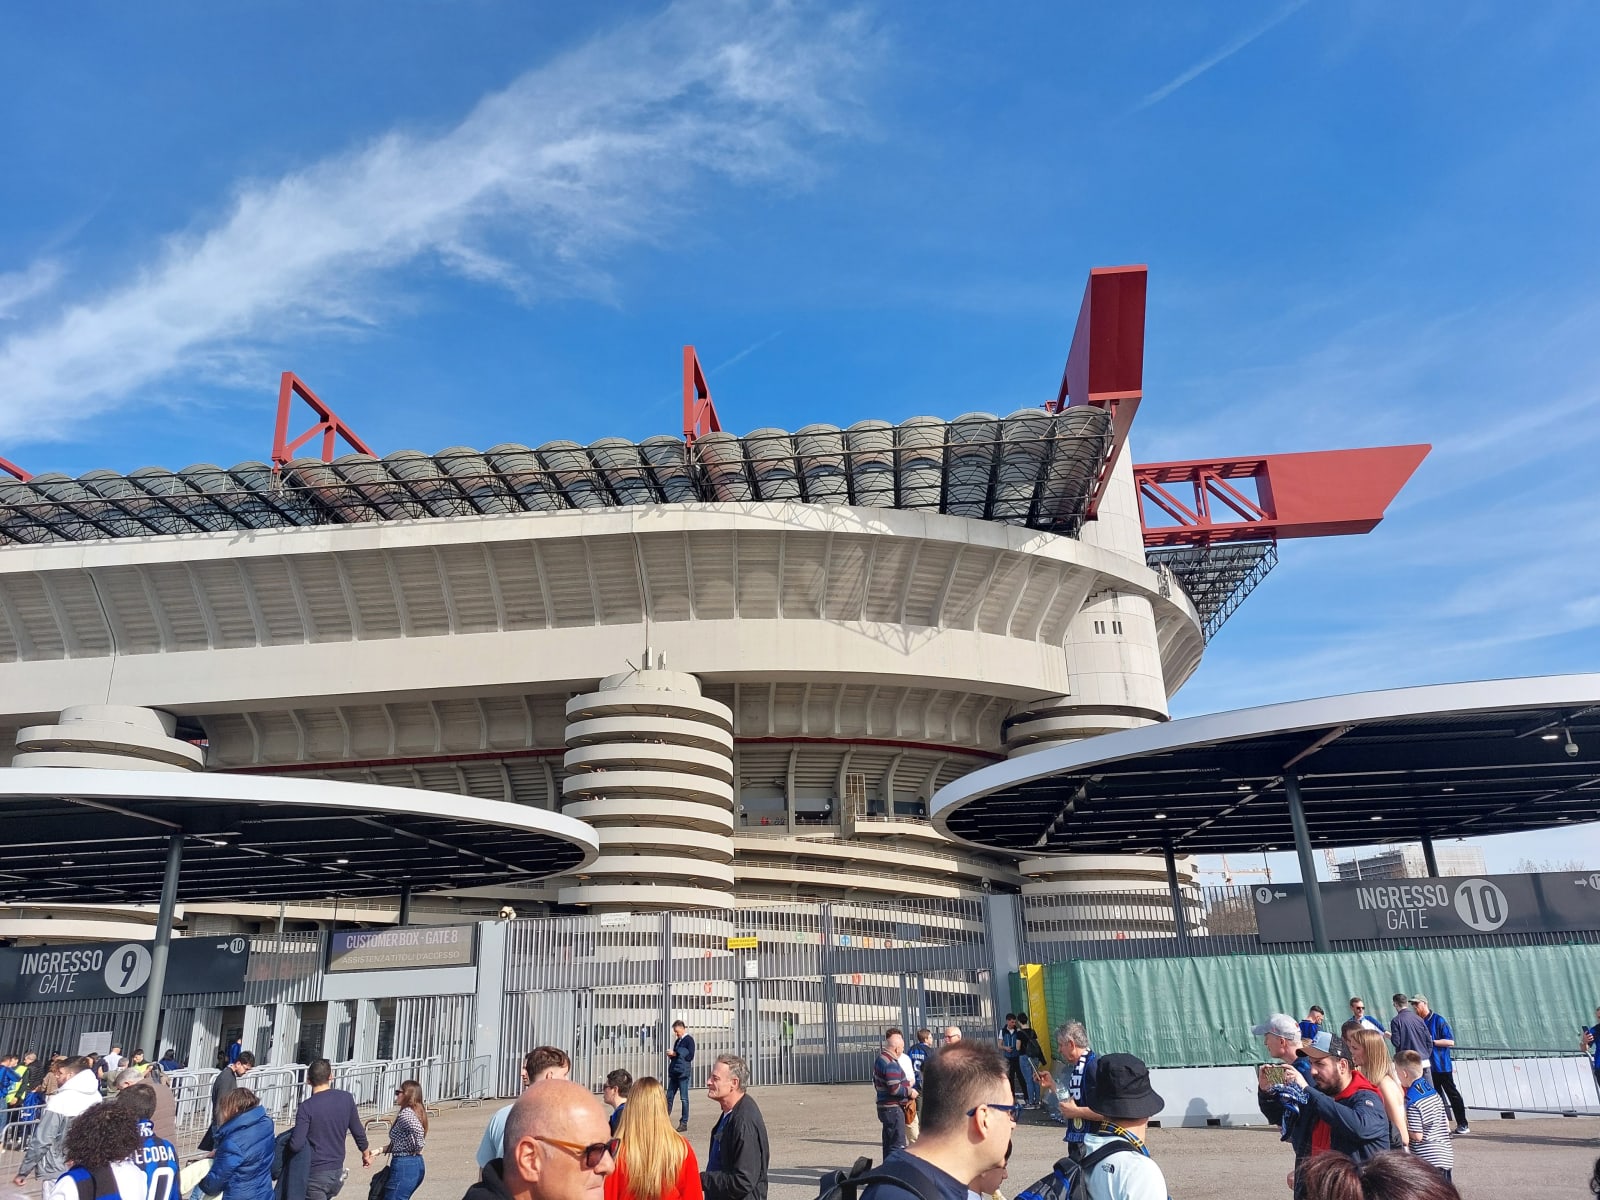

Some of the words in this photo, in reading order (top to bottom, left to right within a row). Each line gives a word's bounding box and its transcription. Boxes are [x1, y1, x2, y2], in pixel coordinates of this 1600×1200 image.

[1356, 884, 1449, 910] INGRESSO
[1461, 885, 1501, 925] 10
[1387, 908, 1428, 930] GATE
[346, 933, 398, 949] CUSTOMER
[399, 931, 419, 946] BOX
[425, 930, 451, 945] GATE
[451, 929, 458, 943] 8
[20, 949, 103, 975] INGRESSO
[342, 954, 390, 964] ASSISTENZA
[416, 950, 460, 960] D'ACCESSO
[119, 950, 137, 988] 9
[38, 972, 79, 994] GATE
[132, 1145, 176, 1165] ECOBA
